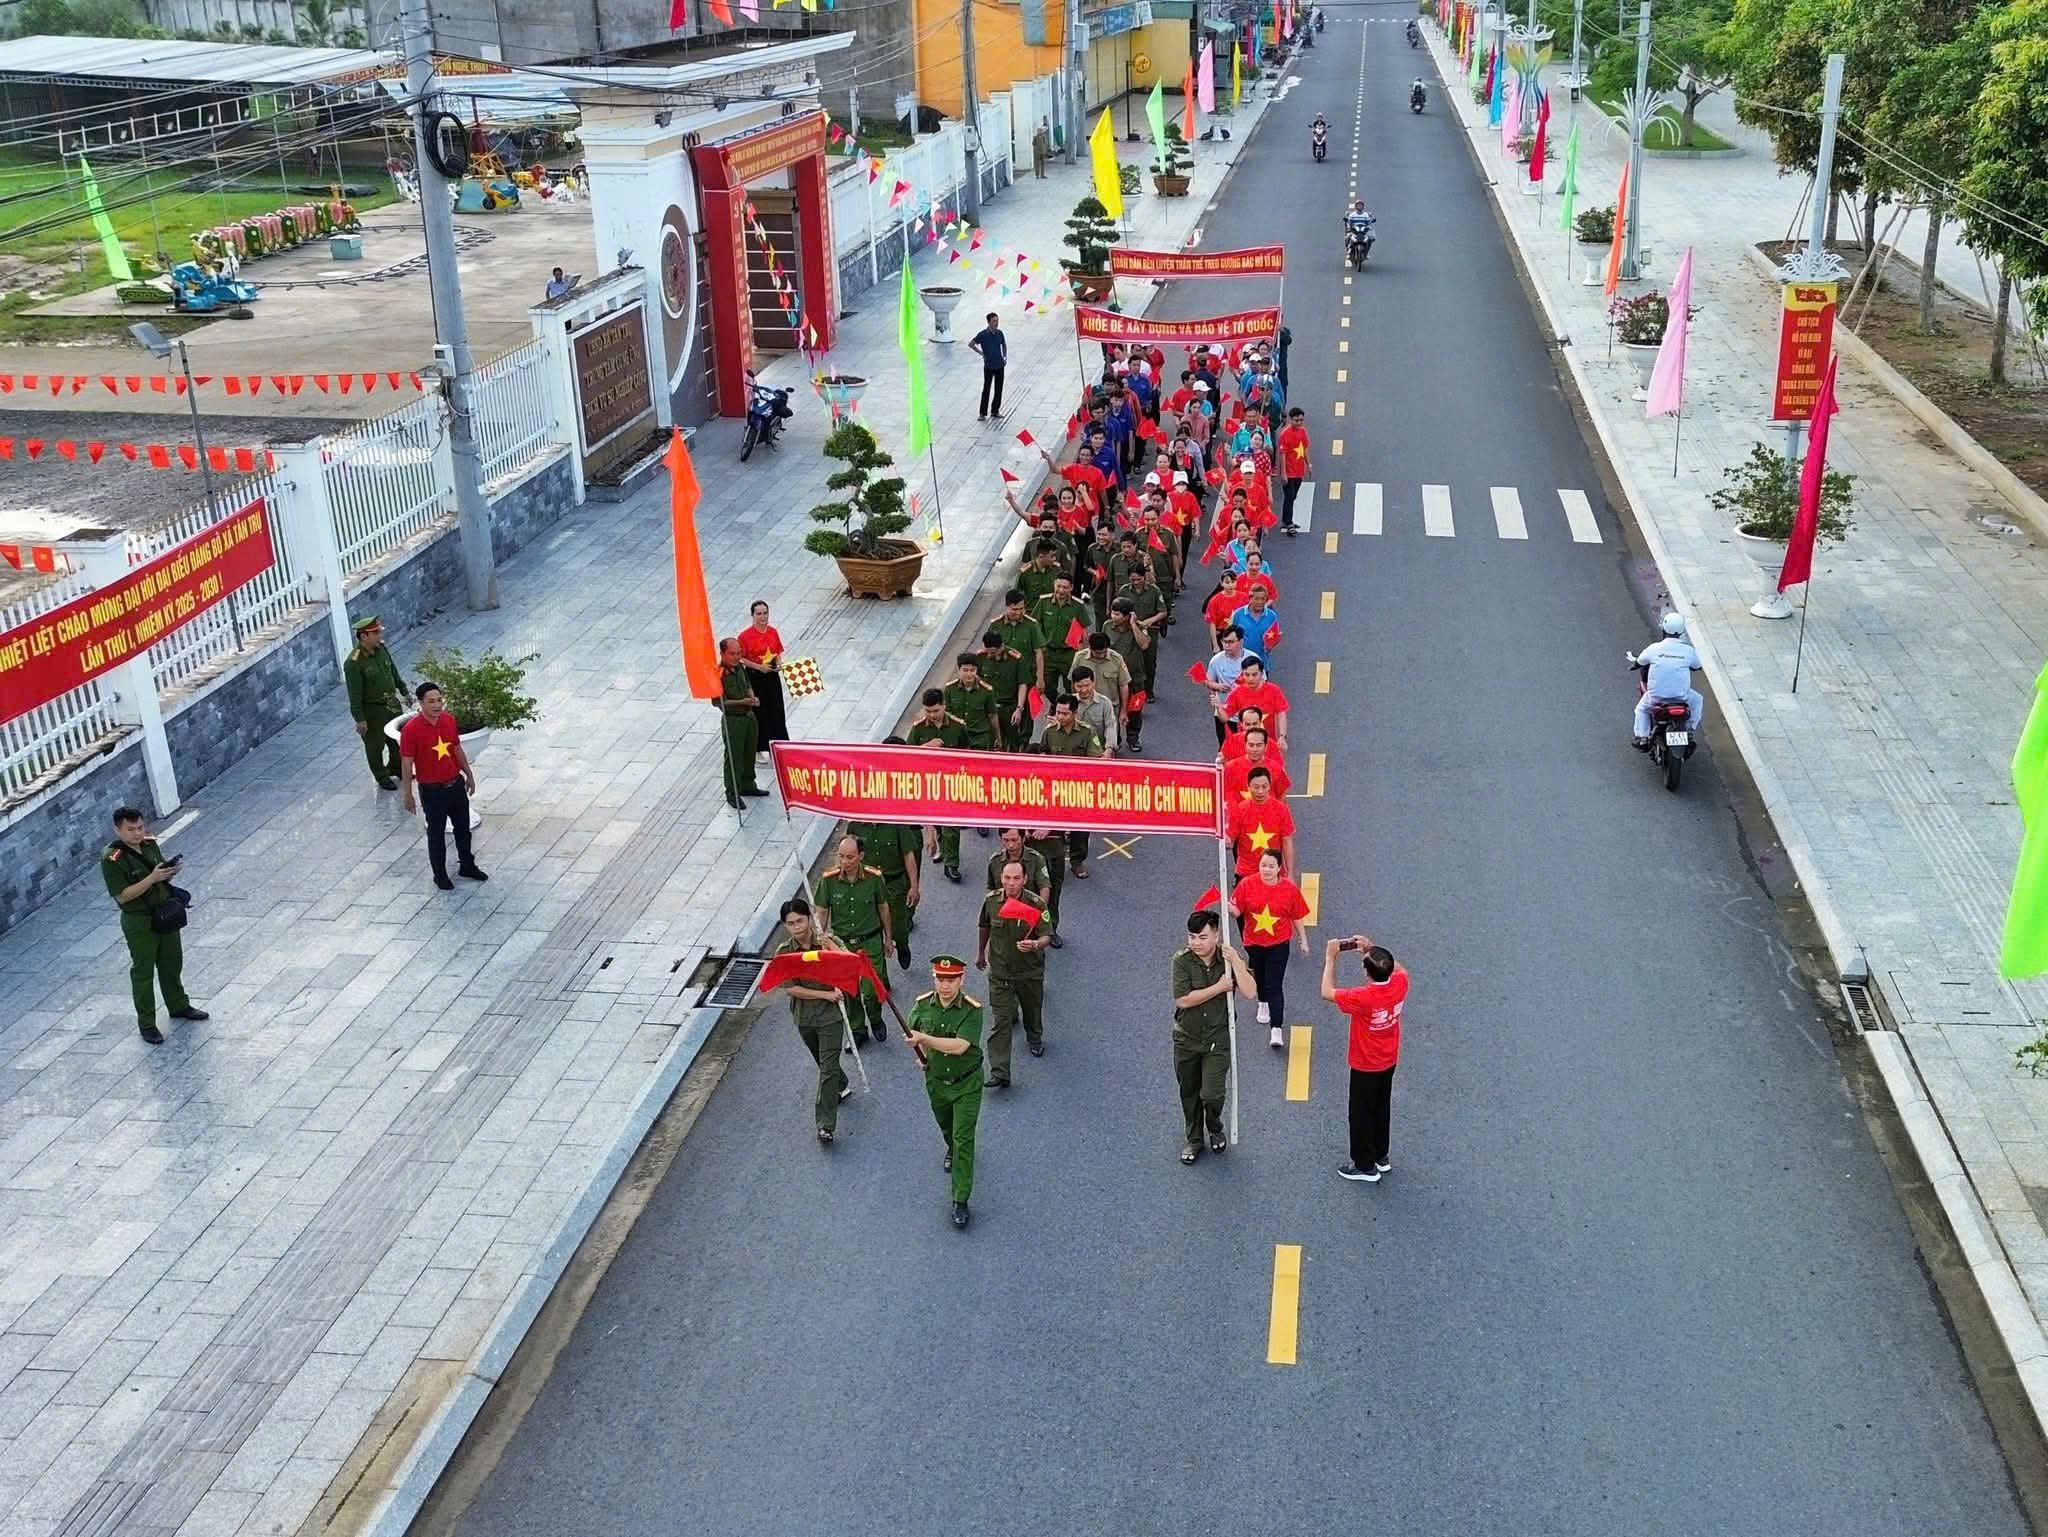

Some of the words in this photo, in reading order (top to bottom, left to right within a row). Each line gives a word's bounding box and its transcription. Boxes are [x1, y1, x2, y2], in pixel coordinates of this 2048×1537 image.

[1082, 314, 1108, 332] KHỎE
[1111, 317, 1124, 332] ĐỂ
[1127, 321, 1146, 334] XÂY
[1218, 320, 1229, 337] VỆ
[1233, 316, 1245, 334] TỔ
[1247, 314, 1273, 334] QUỐC
[30, 625, 56, 656] LIỆT
[57, 610, 90, 643] CHÀO
[90, 597, 124, 628] MỪNG
[124, 584, 141, 612] ĐẠI
[140, 573, 157, 602] HỘI
[156, 564, 172, 592] ĐẠI
[171, 550, 190, 582] BIỂU
[190, 542, 212, 571] ĐẢNG
[211, 532, 223, 559] BỘ
[222, 525, 234, 550] XÃ
[234, 519, 248, 543] TÂN
[248, 512, 262, 533] TRỤ
[80, 640, 104, 672] LẦN
[104, 628, 127, 660] THỨ
[135, 609, 164, 644] NHIỆM
[164, 598, 175, 624] KỲ
[175, 590, 196, 618] 2025
[200, 574, 220, 602] 2030
[787, 766, 812, 796] HỌC
[813, 764, 836, 802] TẬP
[840, 764, 857, 798] VÀ
[861, 765, 887, 798] LÀM
[890, 771, 922, 800] THEO
[926, 771, 942, 801] TƯ
[944, 765, 989, 806] TƯỞNG,
[991, 776, 1016, 811] ĐẠO
[1019, 773, 1048, 810] ĐỨC,
[1052, 779, 1094, 809] PHONG
[1098, 777, 1131, 810] CÁCH
[1134, 776, 1151, 812] HỒ
[1154, 780, 1175, 812] CHÍ
[1179, 786, 1213, 814] MINH
